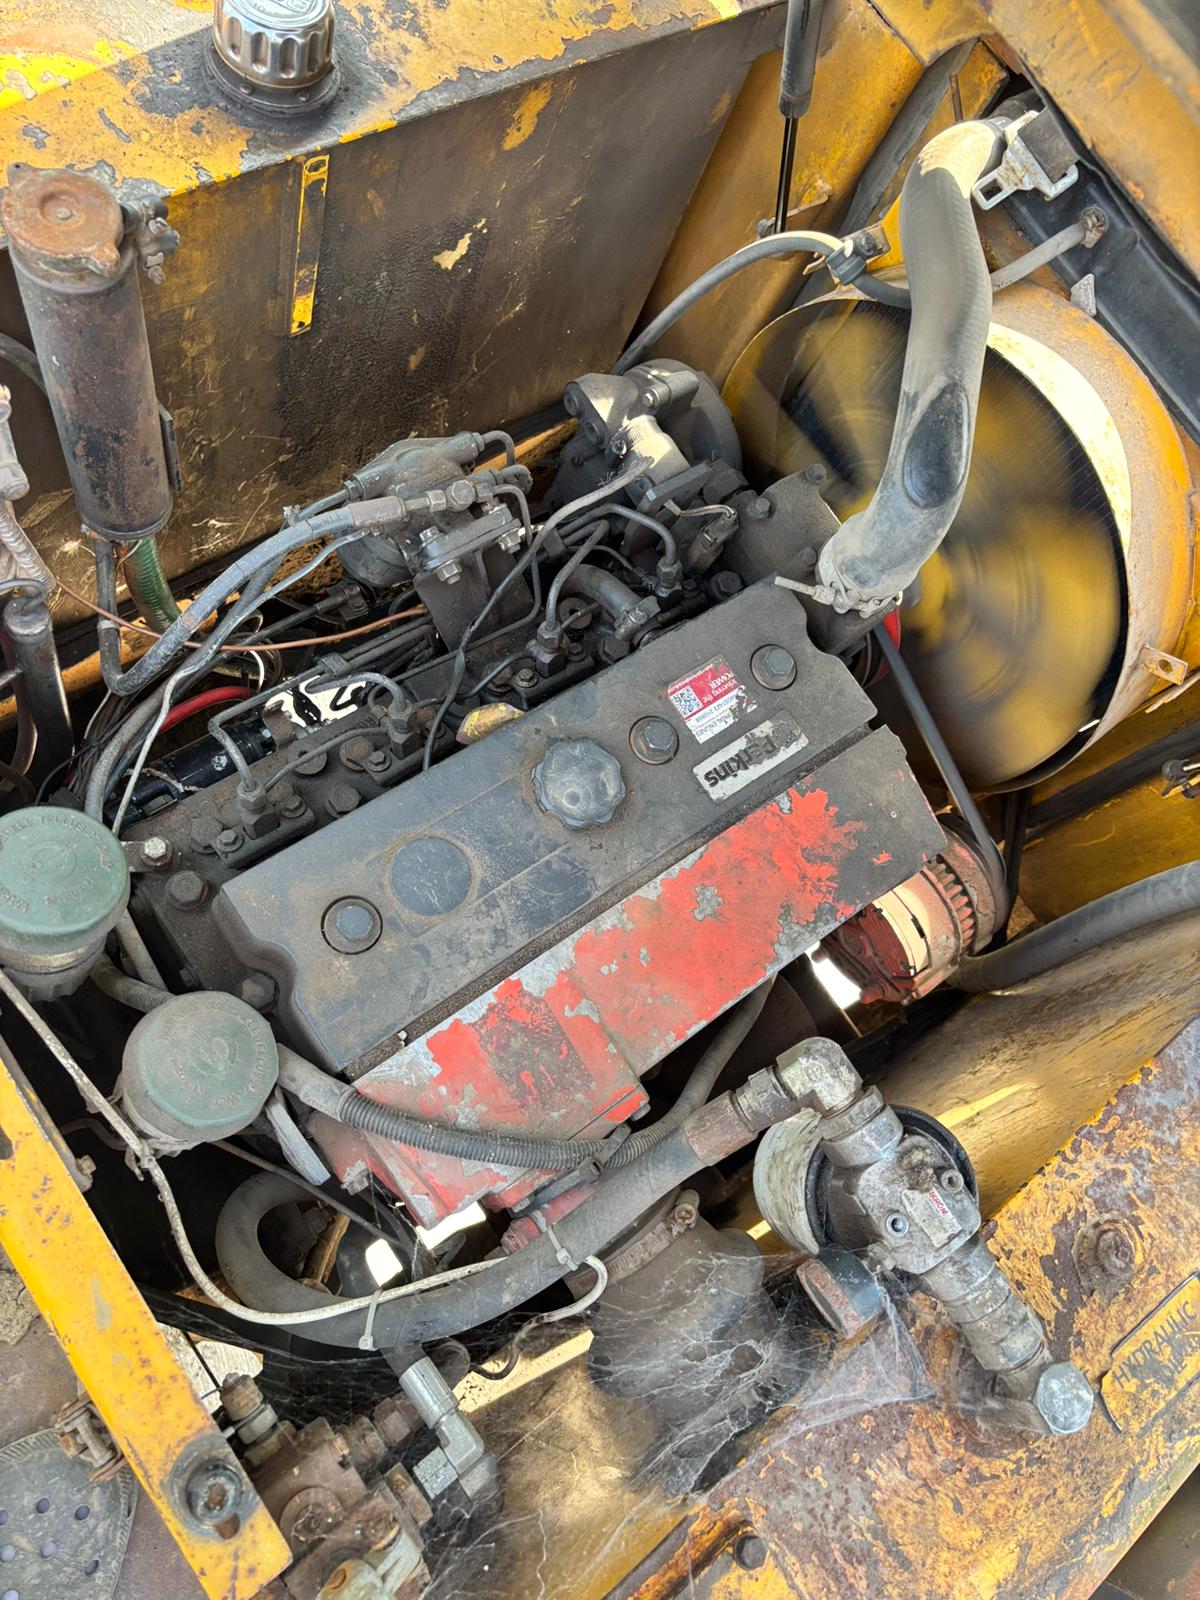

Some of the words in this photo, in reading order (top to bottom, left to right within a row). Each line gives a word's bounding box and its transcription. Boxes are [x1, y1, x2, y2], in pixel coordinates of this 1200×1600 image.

[704, 735, 779, 788] Perkins
[927, 1190, 949, 1217] IKRON
[1111, 1300, 1197, 1390] HYDRAULIC
